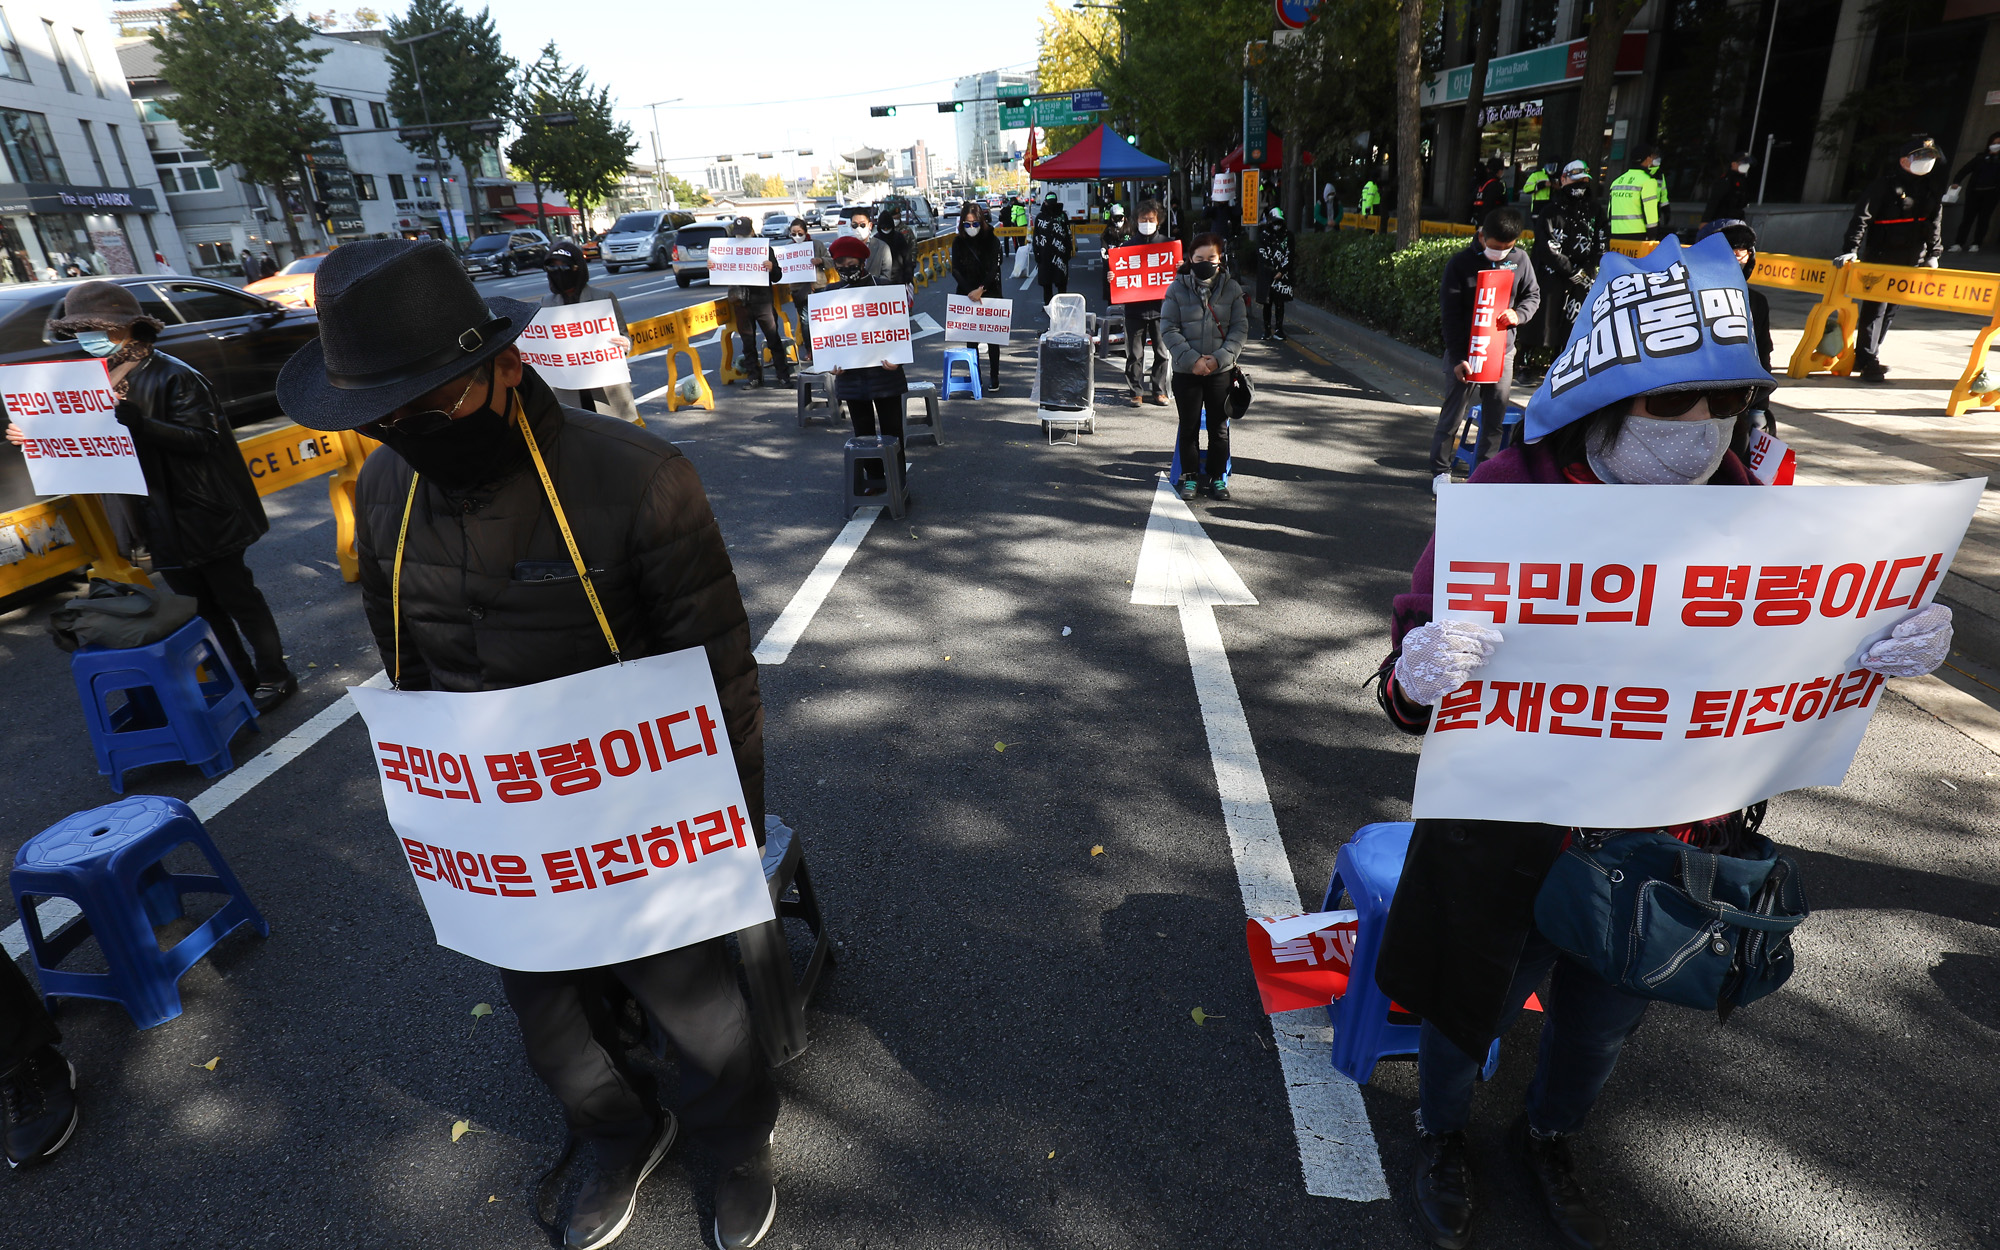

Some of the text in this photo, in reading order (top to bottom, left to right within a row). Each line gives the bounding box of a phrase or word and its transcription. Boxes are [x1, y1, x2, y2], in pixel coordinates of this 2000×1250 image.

[1496, 60, 1530, 77] Hana Bank
[1074, 93, 1081, 103] P
[1486, 107, 1499, 123] The
[1500, 105, 1523, 121] Coffee
[58, 191, 78, 206] The
[95, 192, 134, 207] HANBOK
[710, 246, 734, 256] 국민의
[735, 246, 768, 256] 명령이다
[786, 249, 813, 260] 명령이다
[1115, 251, 1174, 271] 소통 불가
[790, 263, 815, 273] 퇴진하라
[1757, 263, 1827, 284] POLICE LINE
[1116, 271, 1174, 290] 독재 타도
[1592, 260, 1687, 323] 영원한
[1886, 277, 1993, 303] POLICE LINE
[810, 300, 907, 323] 국민의 명령이다
[948, 303, 1010, 319] 국민의 명령이다
[1474, 287, 1497, 327] 타도
[521, 316, 615, 340] 민의 명령이다
[631, 322, 675, 345] POLICE LINE
[946, 320, 1010, 334] 문재인은 퇴진하라
[813, 328, 910, 350] 문재인은 퇴진하라
[1551, 287, 1749, 393] 한미동맹
[565, 345, 624, 367] 퇴진하라
[4, 388, 115, 416] 국민의 명령이다
[23, 435, 136, 460] 문재인은 퇴진하라
[1446, 553, 1944, 627] 국민의 명령이다
[1434, 667, 1886, 741] 문재인은 퇴진하라
[377, 704, 718, 804] 국민의 명령이다
[401, 804, 748, 898] 문재인은 퇴진하라
[1270, 930, 1357, 968] 독재
